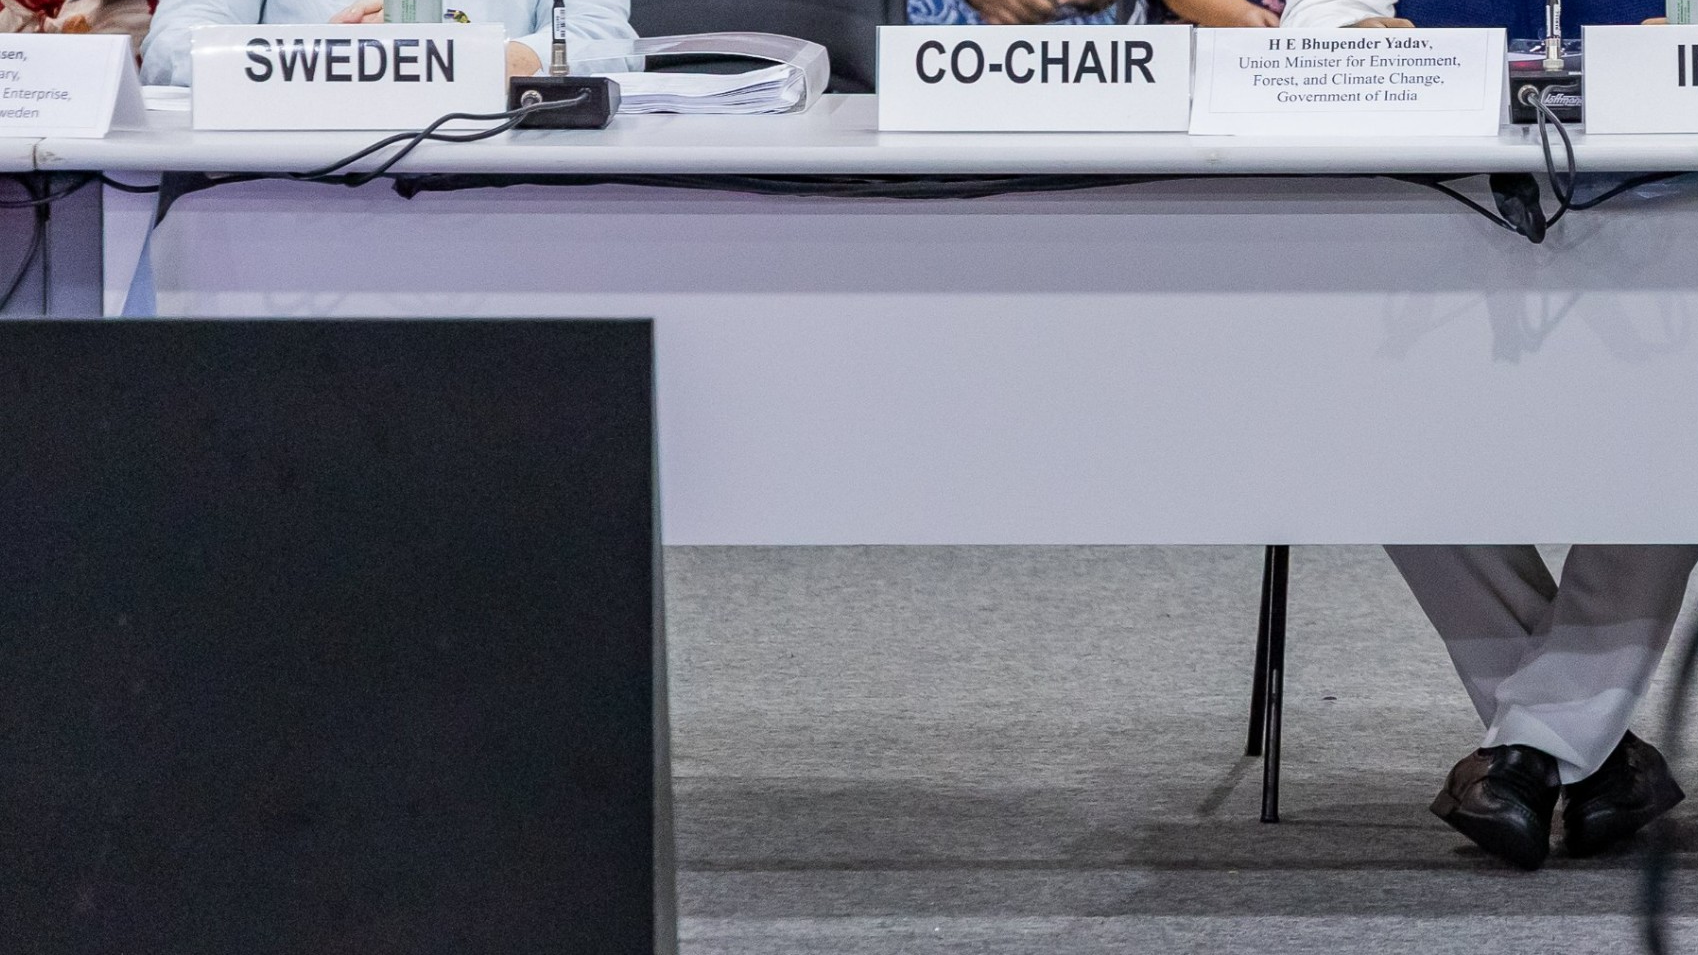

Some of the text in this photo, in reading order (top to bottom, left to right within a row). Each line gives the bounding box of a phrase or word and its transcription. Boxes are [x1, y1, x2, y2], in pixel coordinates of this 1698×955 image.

[1268, 37, 1434, 53] H E Bhupender Yadav,
[0, 50, 27, 62] sen,
[245, 38, 455, 82] SWEDEN
[915, 40, 1156, 84] CO-CHAIR
[1239, 54, 1461, 70] Union Minister for Environment,
[1252, 74, 1299, 87] Forest,
[1303, 73, 1328, 86] and
[1331, 72, 1386, 86] Climate
[3, 87, 72, 102] Enterprise,
[1277, 89, 1418, 103] Government of India
